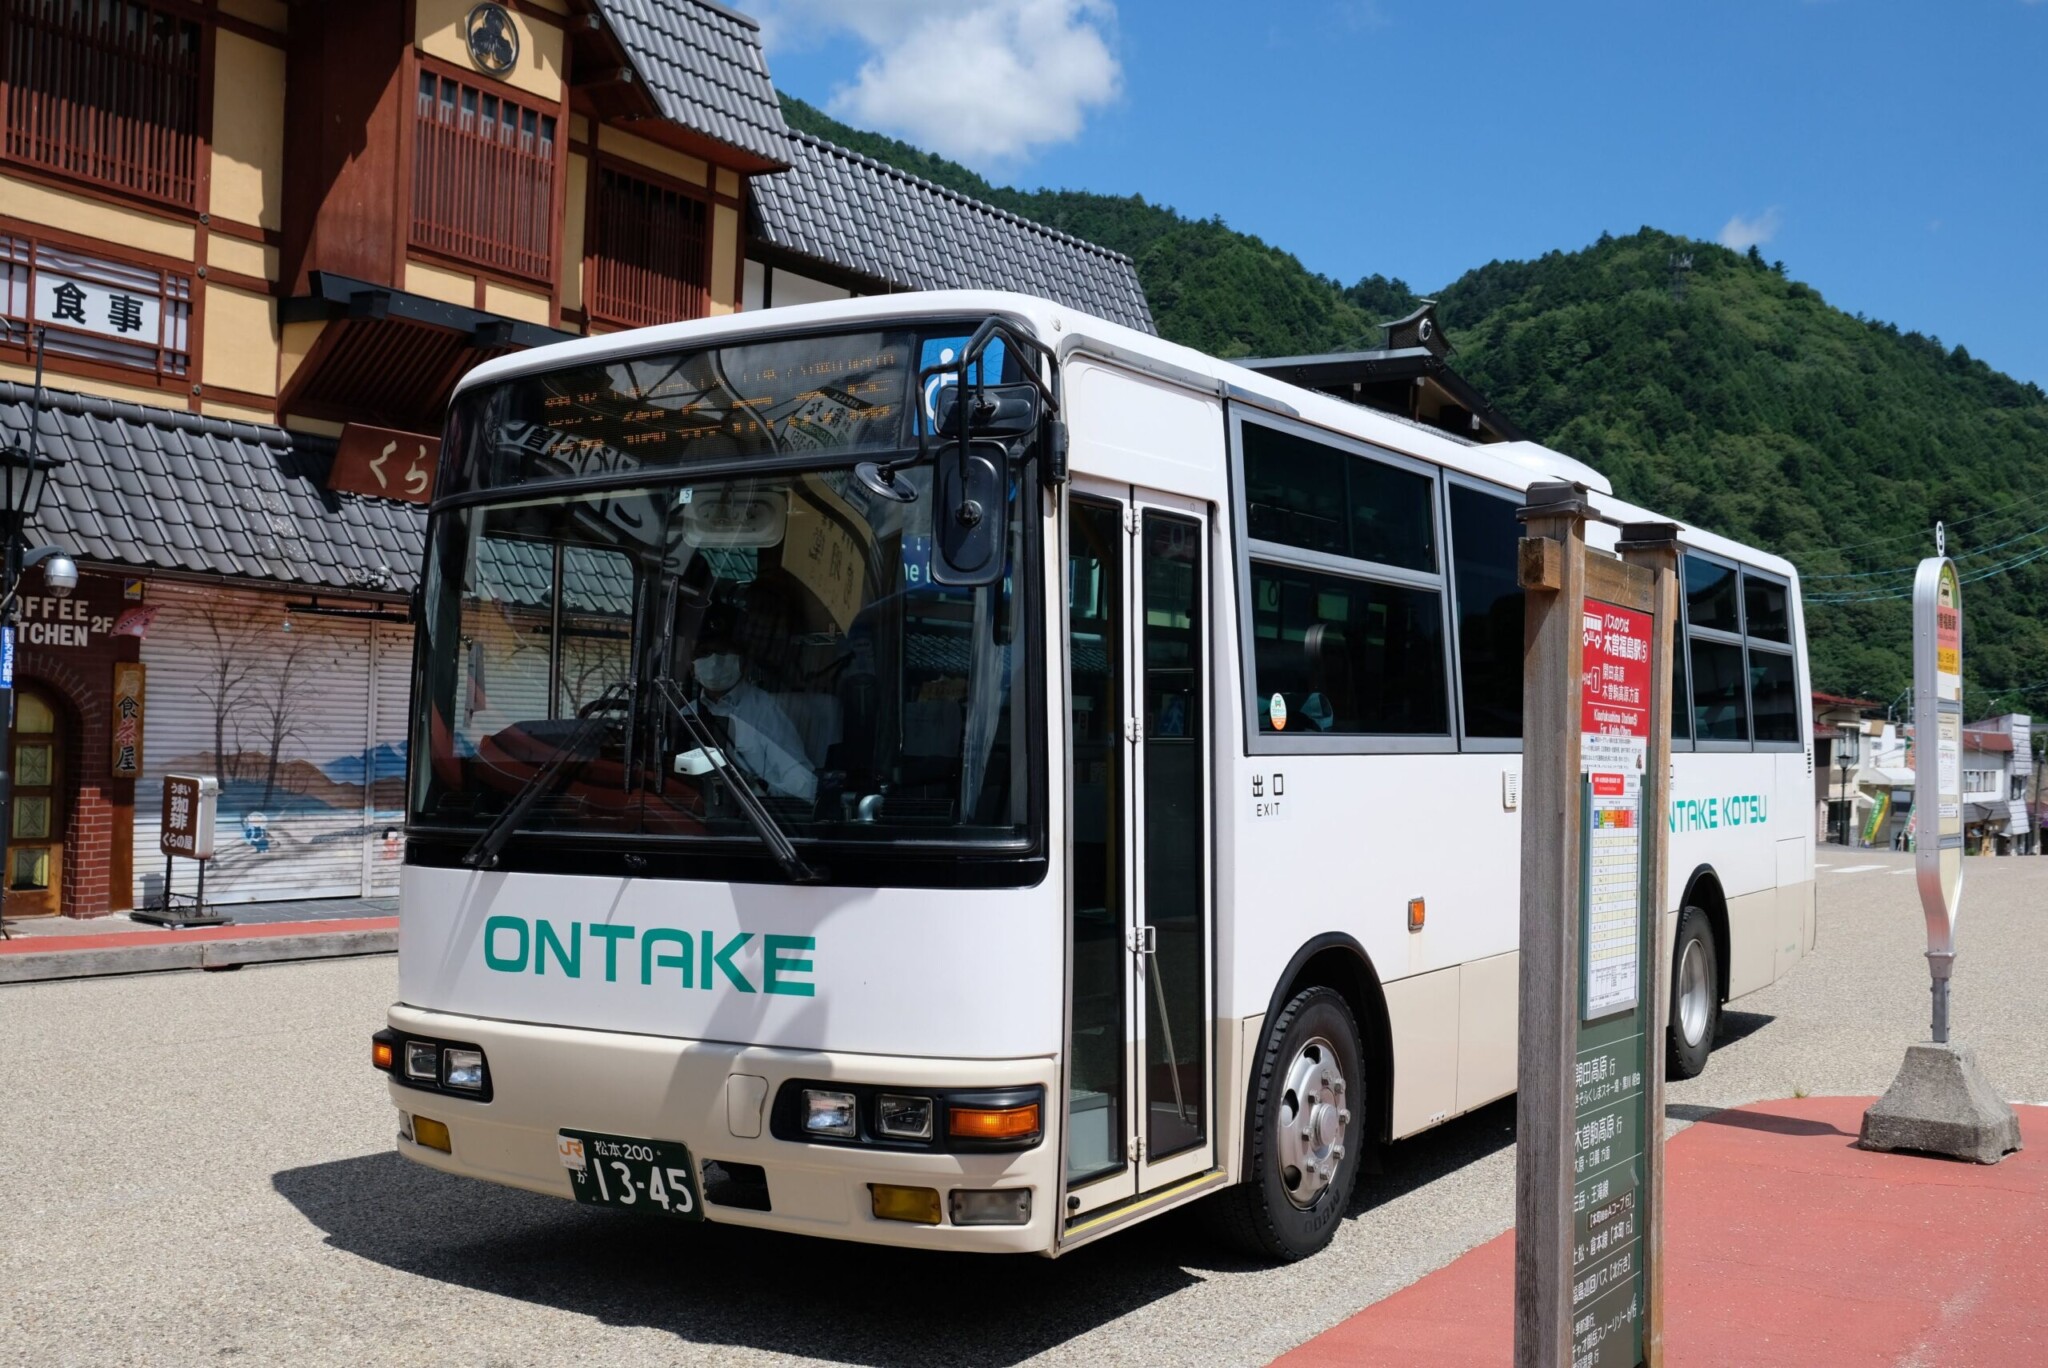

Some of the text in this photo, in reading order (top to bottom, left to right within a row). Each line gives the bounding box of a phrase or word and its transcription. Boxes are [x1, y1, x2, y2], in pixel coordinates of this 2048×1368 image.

[52, 282, 144, 333] 食事
[369, 440, 428, 495] くら
[91, 616, 114, 633] 2F
[1604, 613, 1630, 633] バスのりば
[170, 783, 192, 796] うまい
[1252, 773, 1284, 797] 出口
[169, 796, 190, 831] 珈琲
[1256, 801, 1281, 817] EXIT
[1722, 795, 1767, 827] KOTSU
[162, 832, 194, 850] くらの屋
[484, 915, 816, 998] ONTAKE
[559, 1141, 583, 1158] JR
[593, 1157, 694, 1213] 13-45
